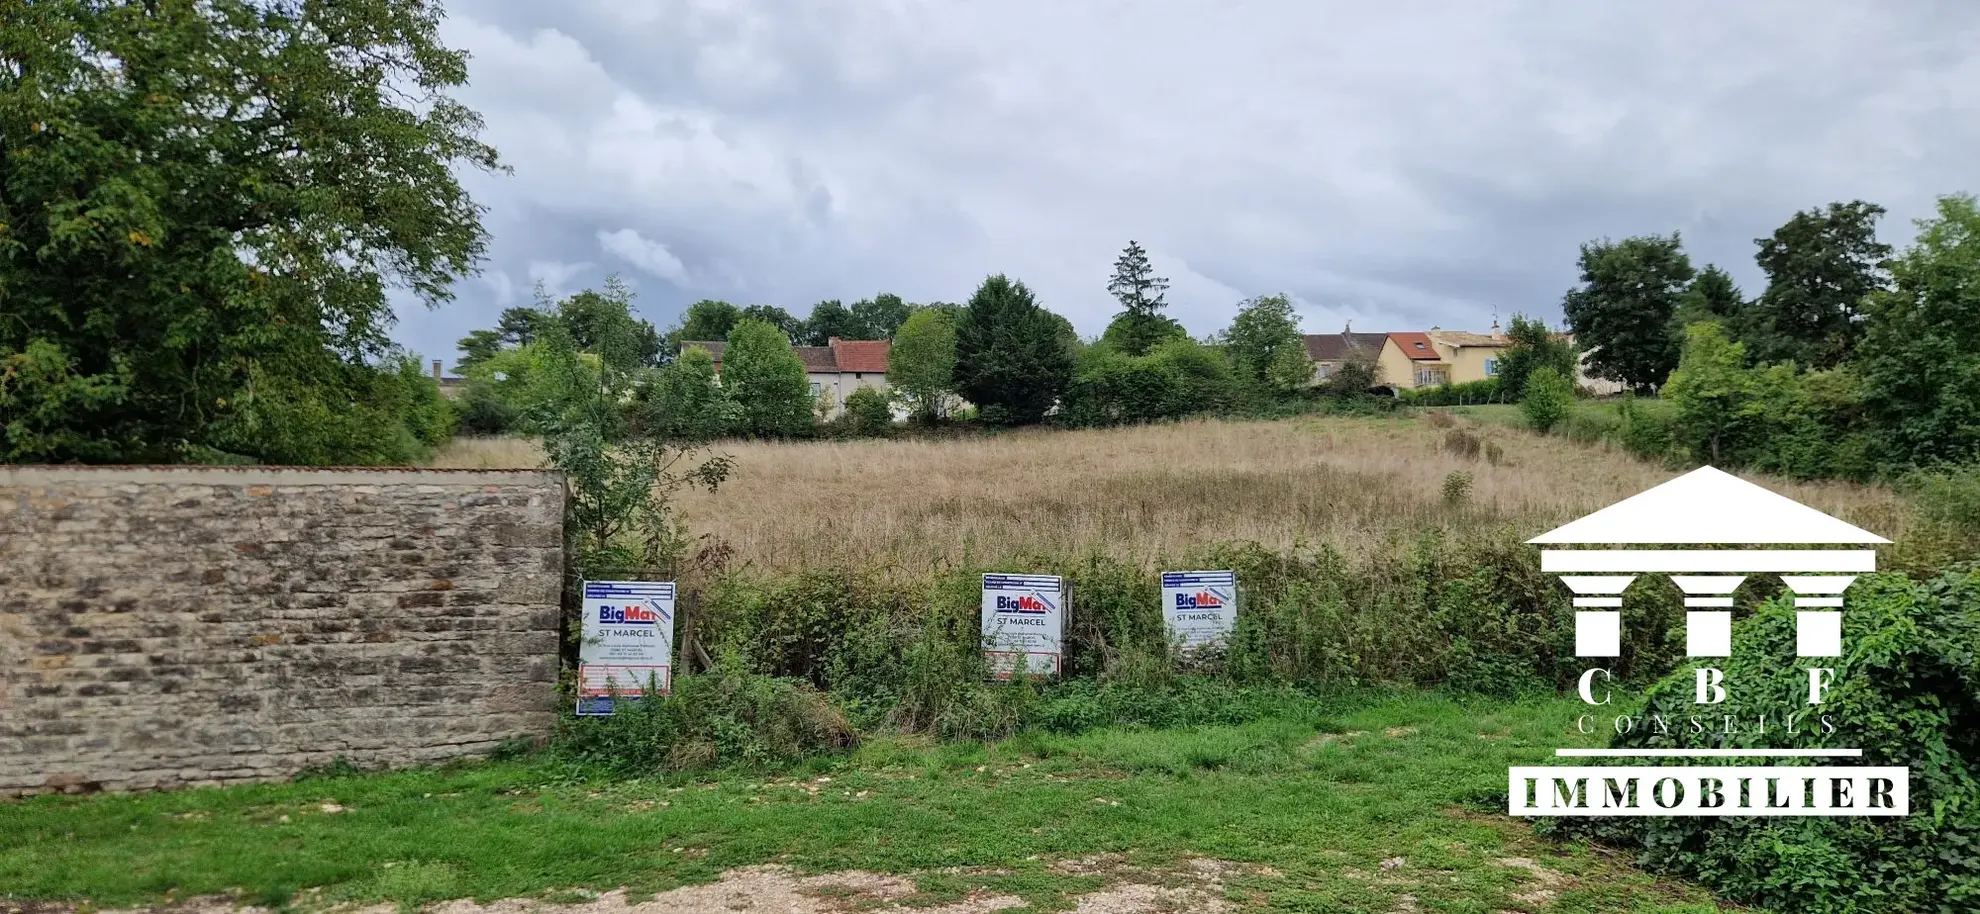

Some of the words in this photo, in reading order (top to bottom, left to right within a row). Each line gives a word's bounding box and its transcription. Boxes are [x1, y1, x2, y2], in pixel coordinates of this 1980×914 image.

[997, 617, 1008, 625] ST
[1010, 618, 1046, 626] MARCEL
[598, 629, 611, 637] ST
[613, 629, 655, 638] MARCEL
